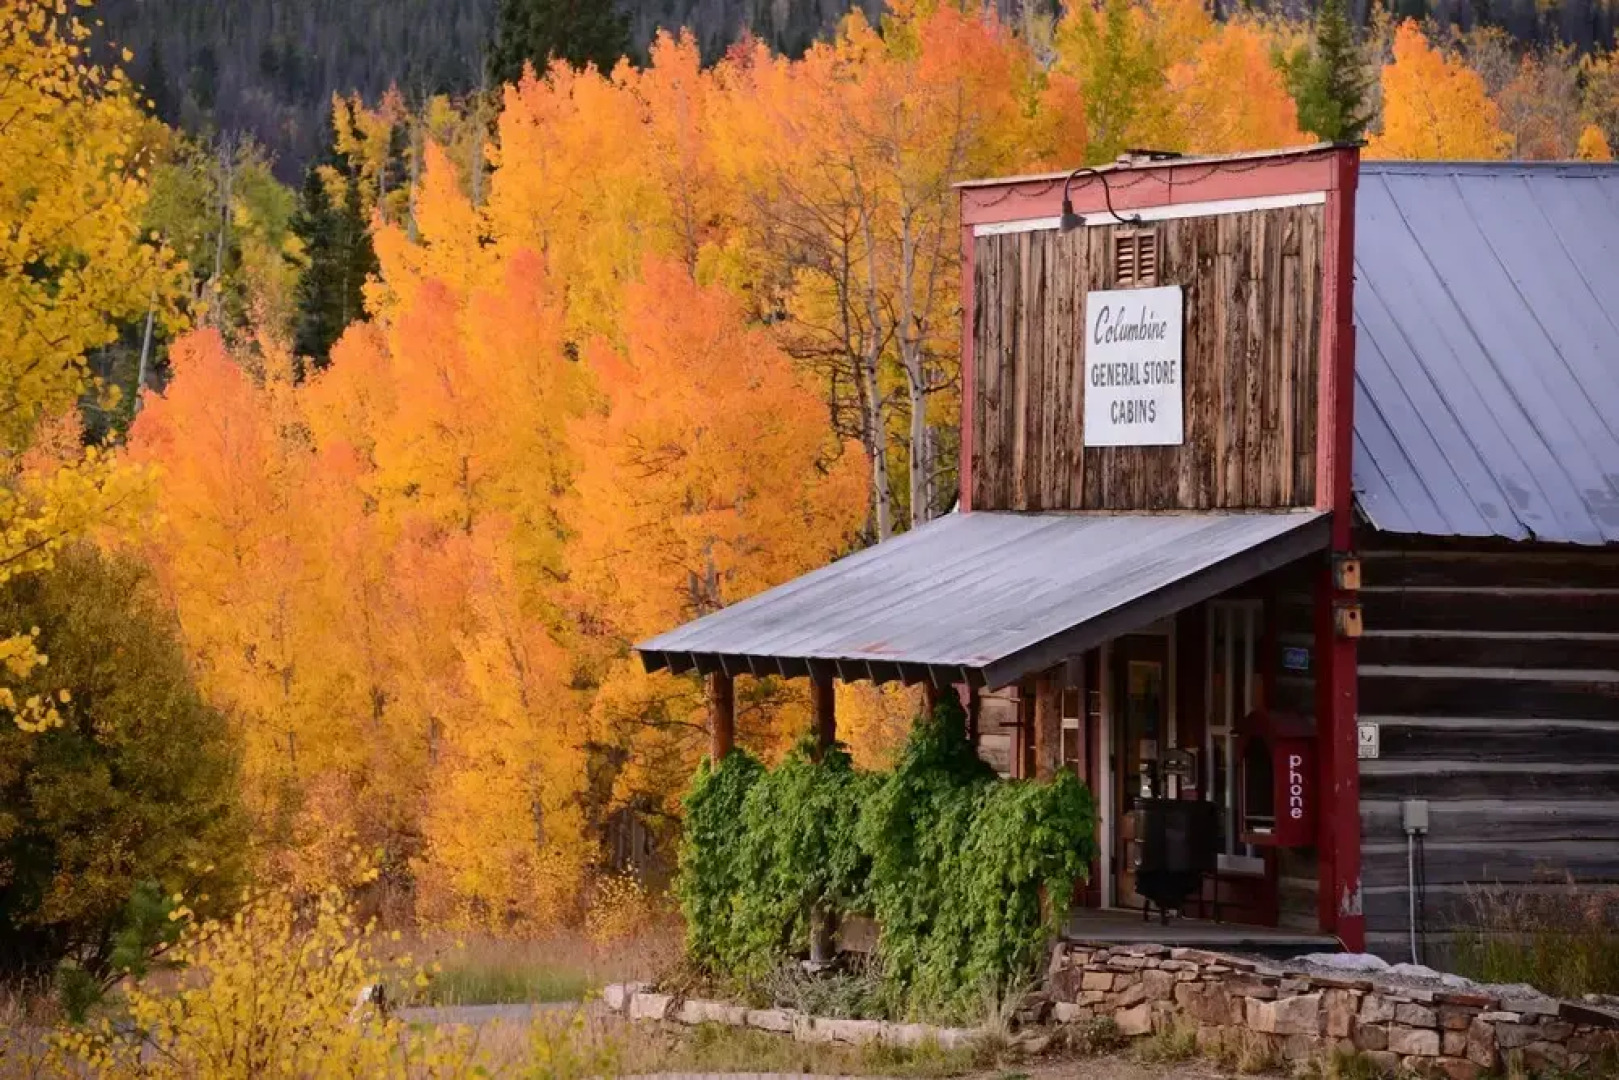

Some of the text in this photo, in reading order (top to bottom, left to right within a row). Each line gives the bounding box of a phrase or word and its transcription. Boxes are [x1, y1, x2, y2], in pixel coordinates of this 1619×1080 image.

[1094, 305, 1168, 345] Columbine
[1091, 360, 1176, 387] GENERAL STORE
[1110, 400, 1157, 425] CABINS
[1289, 754, 1303, 819] phone
